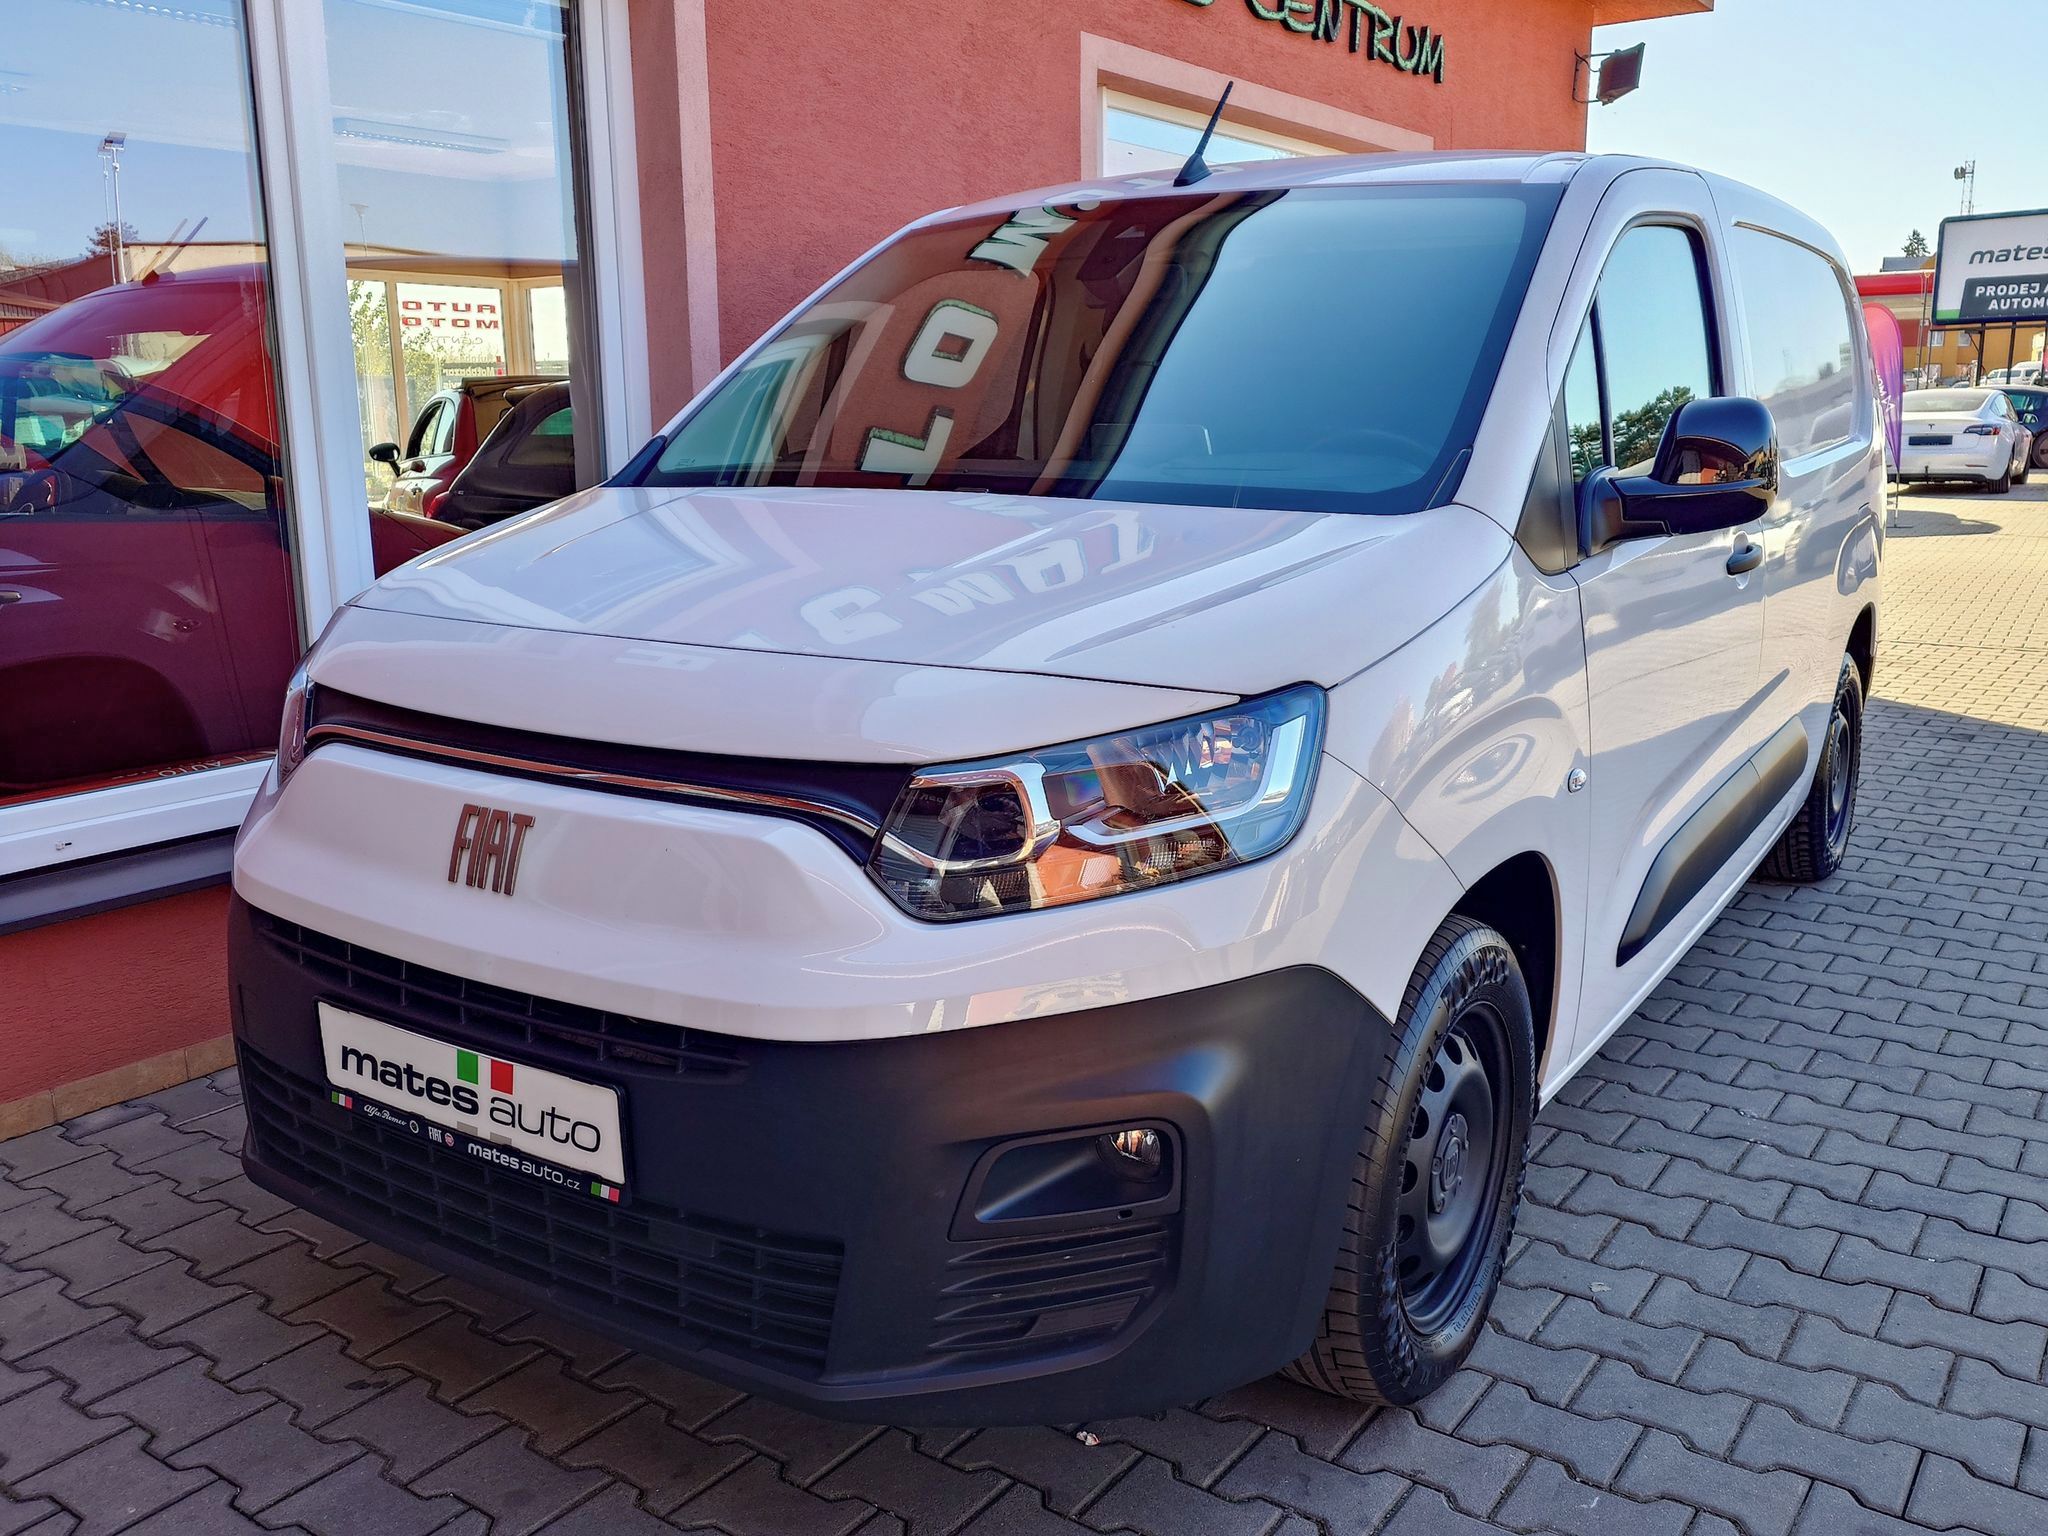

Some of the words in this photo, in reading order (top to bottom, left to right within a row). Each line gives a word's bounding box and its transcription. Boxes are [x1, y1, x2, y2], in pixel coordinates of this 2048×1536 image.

[1975, 283, 2041, 297] PRODEJ
[1988, 297, 2048, 310] AUTOM
[448, 804, 536, 896] FIAT
[341, 1045, 479, 1115] mates
[489, 1097, 601, 1152] auto
[428, 1126, 443, 1143] FIAT
